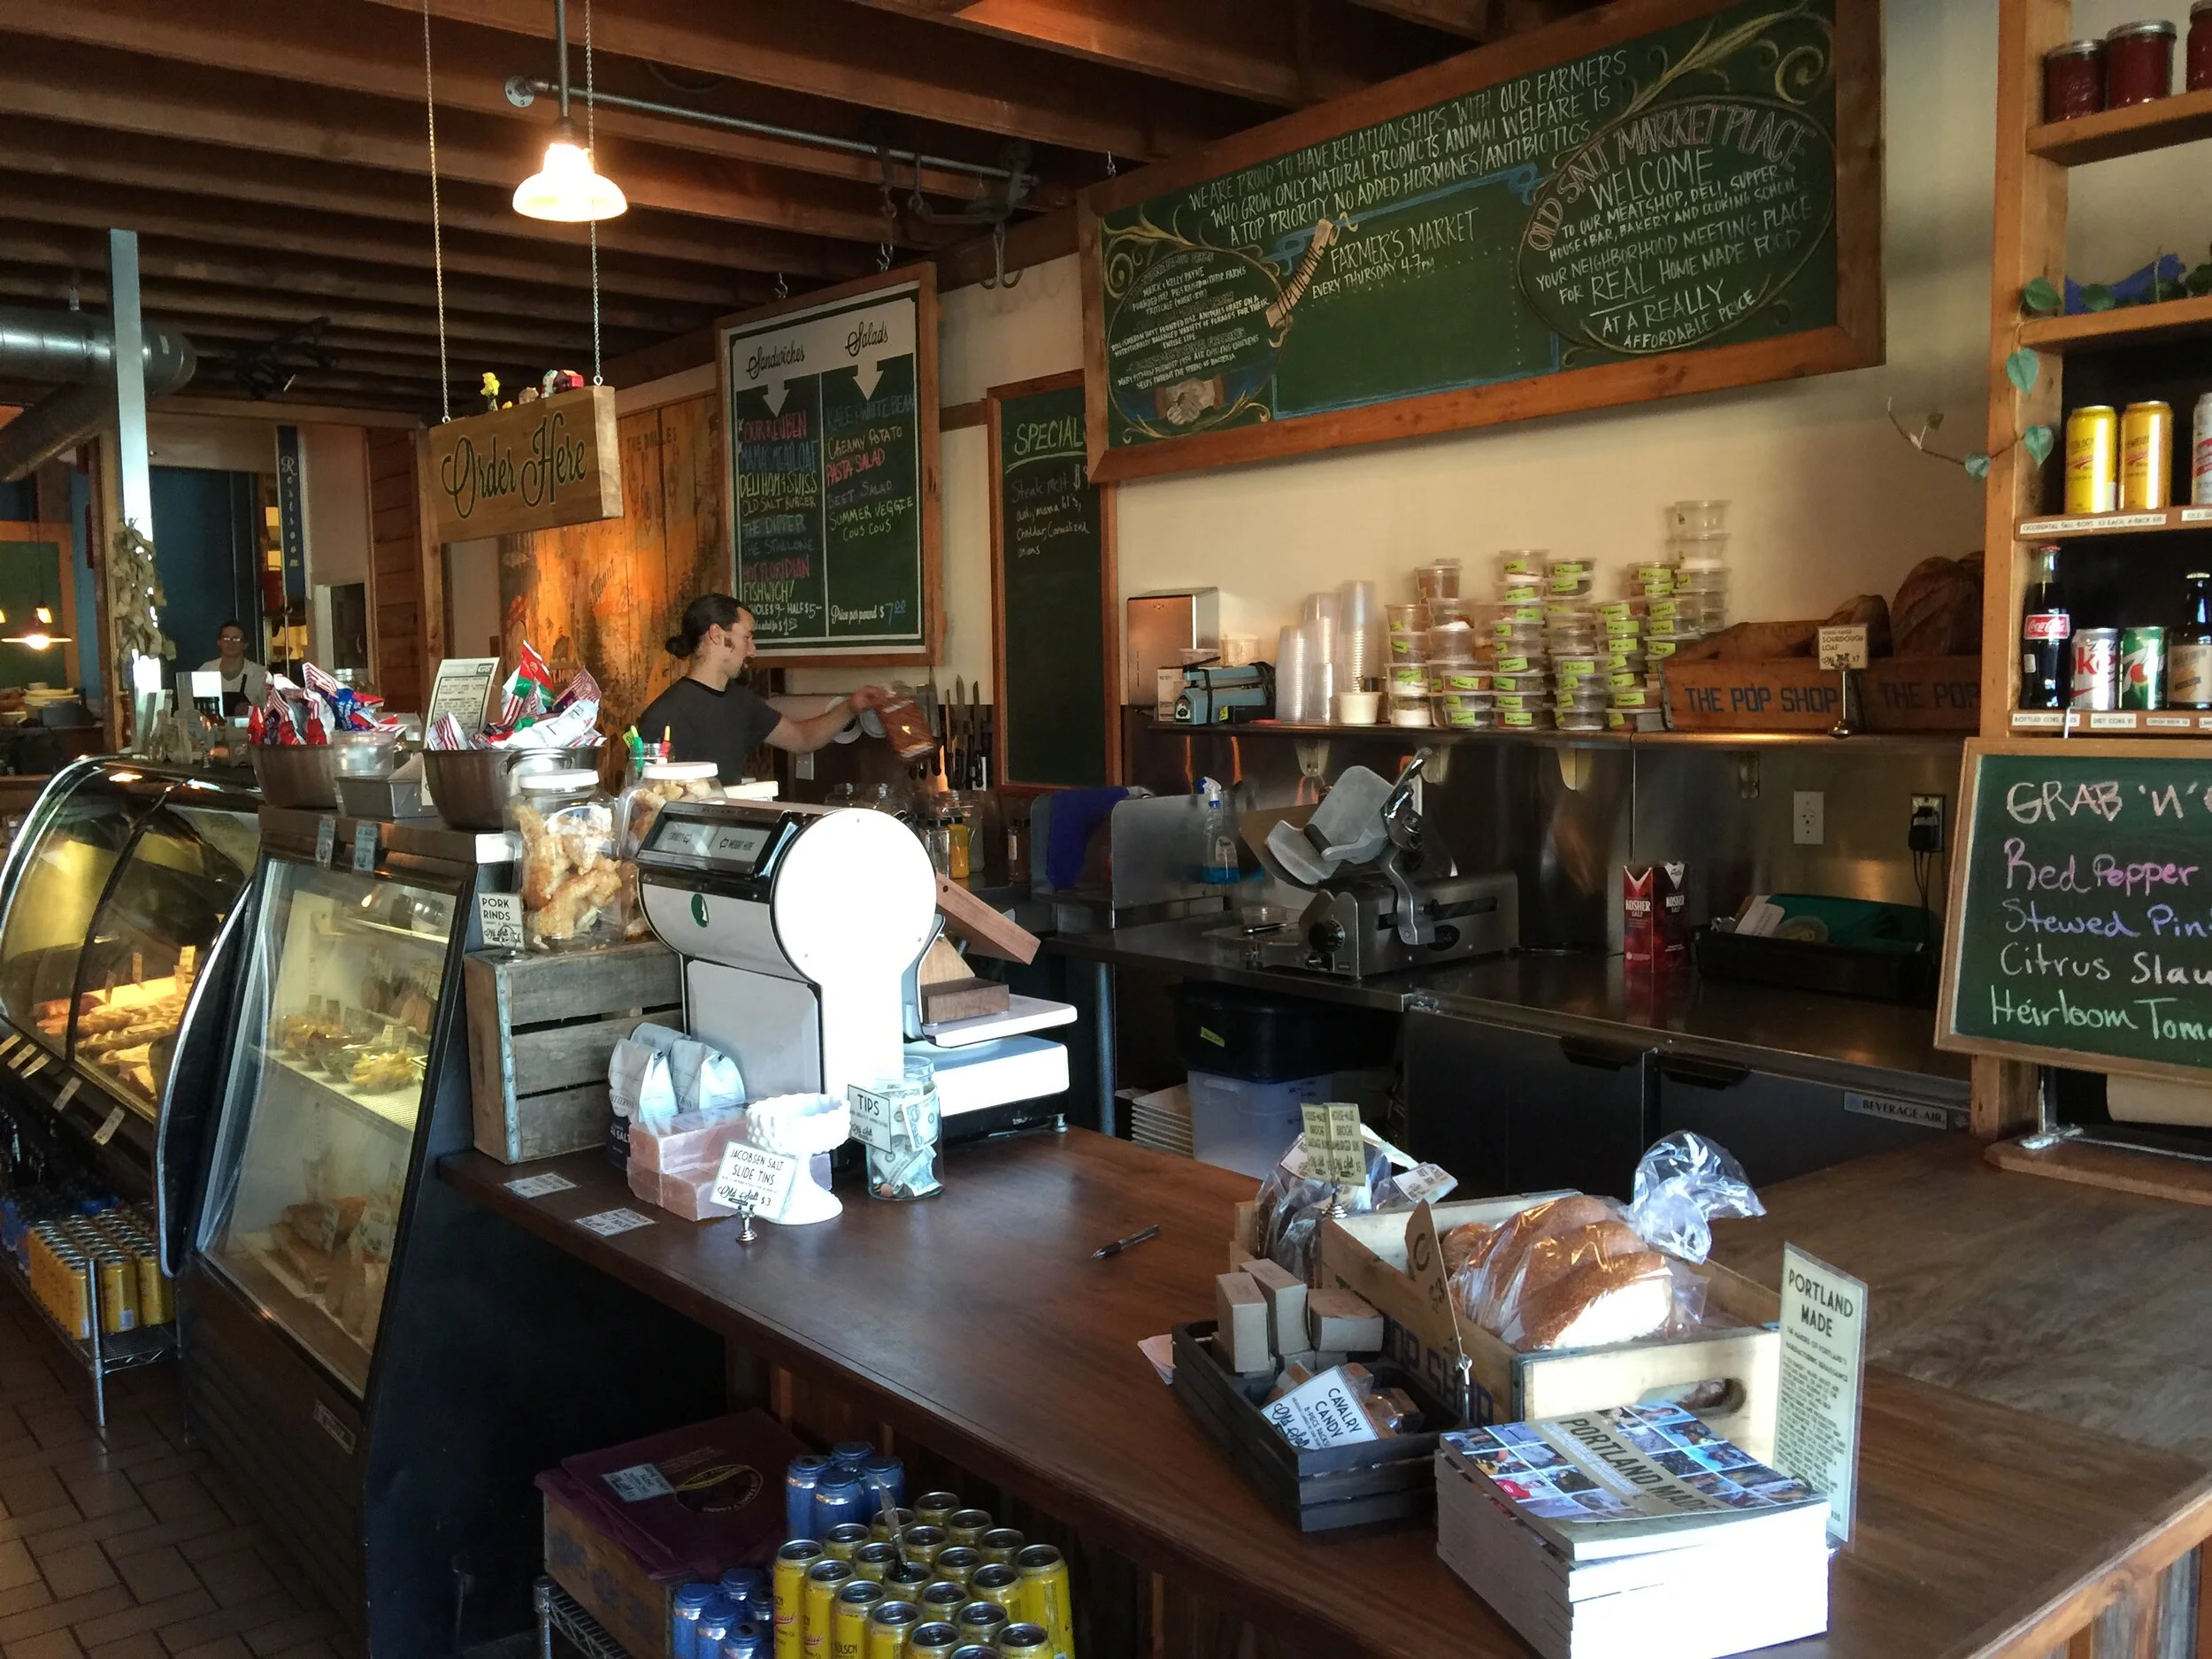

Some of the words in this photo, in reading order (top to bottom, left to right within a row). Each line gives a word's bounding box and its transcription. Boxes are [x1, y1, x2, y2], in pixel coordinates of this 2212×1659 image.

[1189, 187, 1211, 211] WE
[1210, 177, 1233, 204] ARE
[1236, 165, 1275, 196] PROUD
[1277, 157, 1294, 177] TO
[1297, 144, 1331, 174] HAVE
[1332, 105, 1448, 165] RELATIONSHIPS
[1452, 88, 1492, 125] WITH
[1501, 79, 1532, 113] OUR
[1537, 49, 1628, 101] FARMERS
[1210, 204, 1240, 228] WHO
[1240, 190, 1272, 219] GROW
[1275, 177, 1308, 206] ONLY
[1311, 158, 1369, 195] NATURAL
[1371, 134, 1441, 172] PRODUCTS
[1445, 118, 1499, 154] ANIMAL
[1501, 92, 1584, 139] WELFARE
[1594, 84, 1611, 111] IS
[1555, 137, 1610, 204] SALT
[1590, 147, 1715, 211] WELCOME
[1230, 225, 1240, 247] A
[1240, 216, 1265, 242] TOP
[1268, 195, 1328, 235] PRIORITY
[1333, 189, 1355, 213] NO
[1357, 176, 1401, 208] ADDED
[1548, 242, 1581, 263] HOUSE
[1619, 212, 1671, 236] BAKERY
[1675, 204, 1701, 224] AND
[1701, 195, 1751, 217] COOKING
[1754, 180, 1798, 202] SCHOOL
[1561, 223, 1576, 240] TO
[1579, 211, 1603, 236] OUR
[1730, 165, 1778, 191] SUPPER
[1330, 226, 1405, 274] FARMER'S
[1408, 207, 1479, 254] MARKET
[1537, 269, 1569, 294] YOUR
[1571, 234, 1679, 277] NEIGHBORHOOD
[1683, 212, 1758, 248] MEETING
[1762, 195, 1813, 229] PLACE
[1312, 277, 1341, 300] EVERY
[1343, 259, 1398, 287] THURSDAY
[1559, 284, 1584, 305] FOR
[1591, 264, 1657, 306] REAL
[1754, 229, 1802, 258] FOOD
[1602, 311, 1626, 338] AT
[1627, 311, 1640, 331] A
[1643, 278, 1724, 327] REALLY
[1623, 316, 1710, 349] AFFORDABLE
[1717, 288, 1756, 323] PRICE
[746, 339, 806, 380] Sandwiches
[844, 321, 888, 357] Salads
[869, 426, 903, 445] POTATO
[1014, 414, 1087, 456] SPECIAL
[442, 435, 517, 518] Order
[521, 411, 587, 507] Here
[826, 459, 853, 488] PASTA
[855, 448, 886, 472] SALAD
[280, 456, 299, 568] Restroom
[827, 491, 856, 510] BEET
[861, 480, 893, 497] SALAD
[829, 504, 872, 531] SUMMER
[875, 495, 914, 518] VEGGIE
[842, 525, 866, 541] COUS
[869, 518, 892, 536] COUS
[1685, 686, 1724, 713] THE
[1730, 682, 1772, 714] POP
[1780, 686, 1839, 714] SHOP
[1878, 681, 1923, 709] THE
[2006, 780, 2123, 824] GRAB
[2003, 836, 2092, 894] Red
[2093, 852, 2200, 897] Pepper
[482, 897, 510, 909] PORK
[483, 910, 511, 921] RINDS
[1625, 899, 1651, 912] KOSHER
[1666, 895, 1685, 908] KOSHER
[2002, 898, 2141, 938] Stewed
[2000, 941, 2111, 981] Citrus
[1990, 984, 2139, 1030] Heirloom
[857, 1094, 880, 1117] TIPS
[730, 1148, 766, 1168] JACOBSEN
[767, 1157, 785, 1171] SALT
[732, 1164, 755, 1180] SLIDE
[757, 1170, 776, 1186] TINS
[718, 1185, 736, 1199] Old
[739, 1188, 759, 1202] Salt
[1788, 1268, 1854, 1317] PORTLAND
[1801, 1303, 1833, 1338] MADE
[1271, 1402, 1295, 1427] Old
[1315, 1401, 1344, 1438] CANDY
[1327, 1387, 1363, 1433] CAVALRY
[1559, 1418, 1663, 1485] PORTLAND
[1646, 1484, 1722, 1510] MADE
